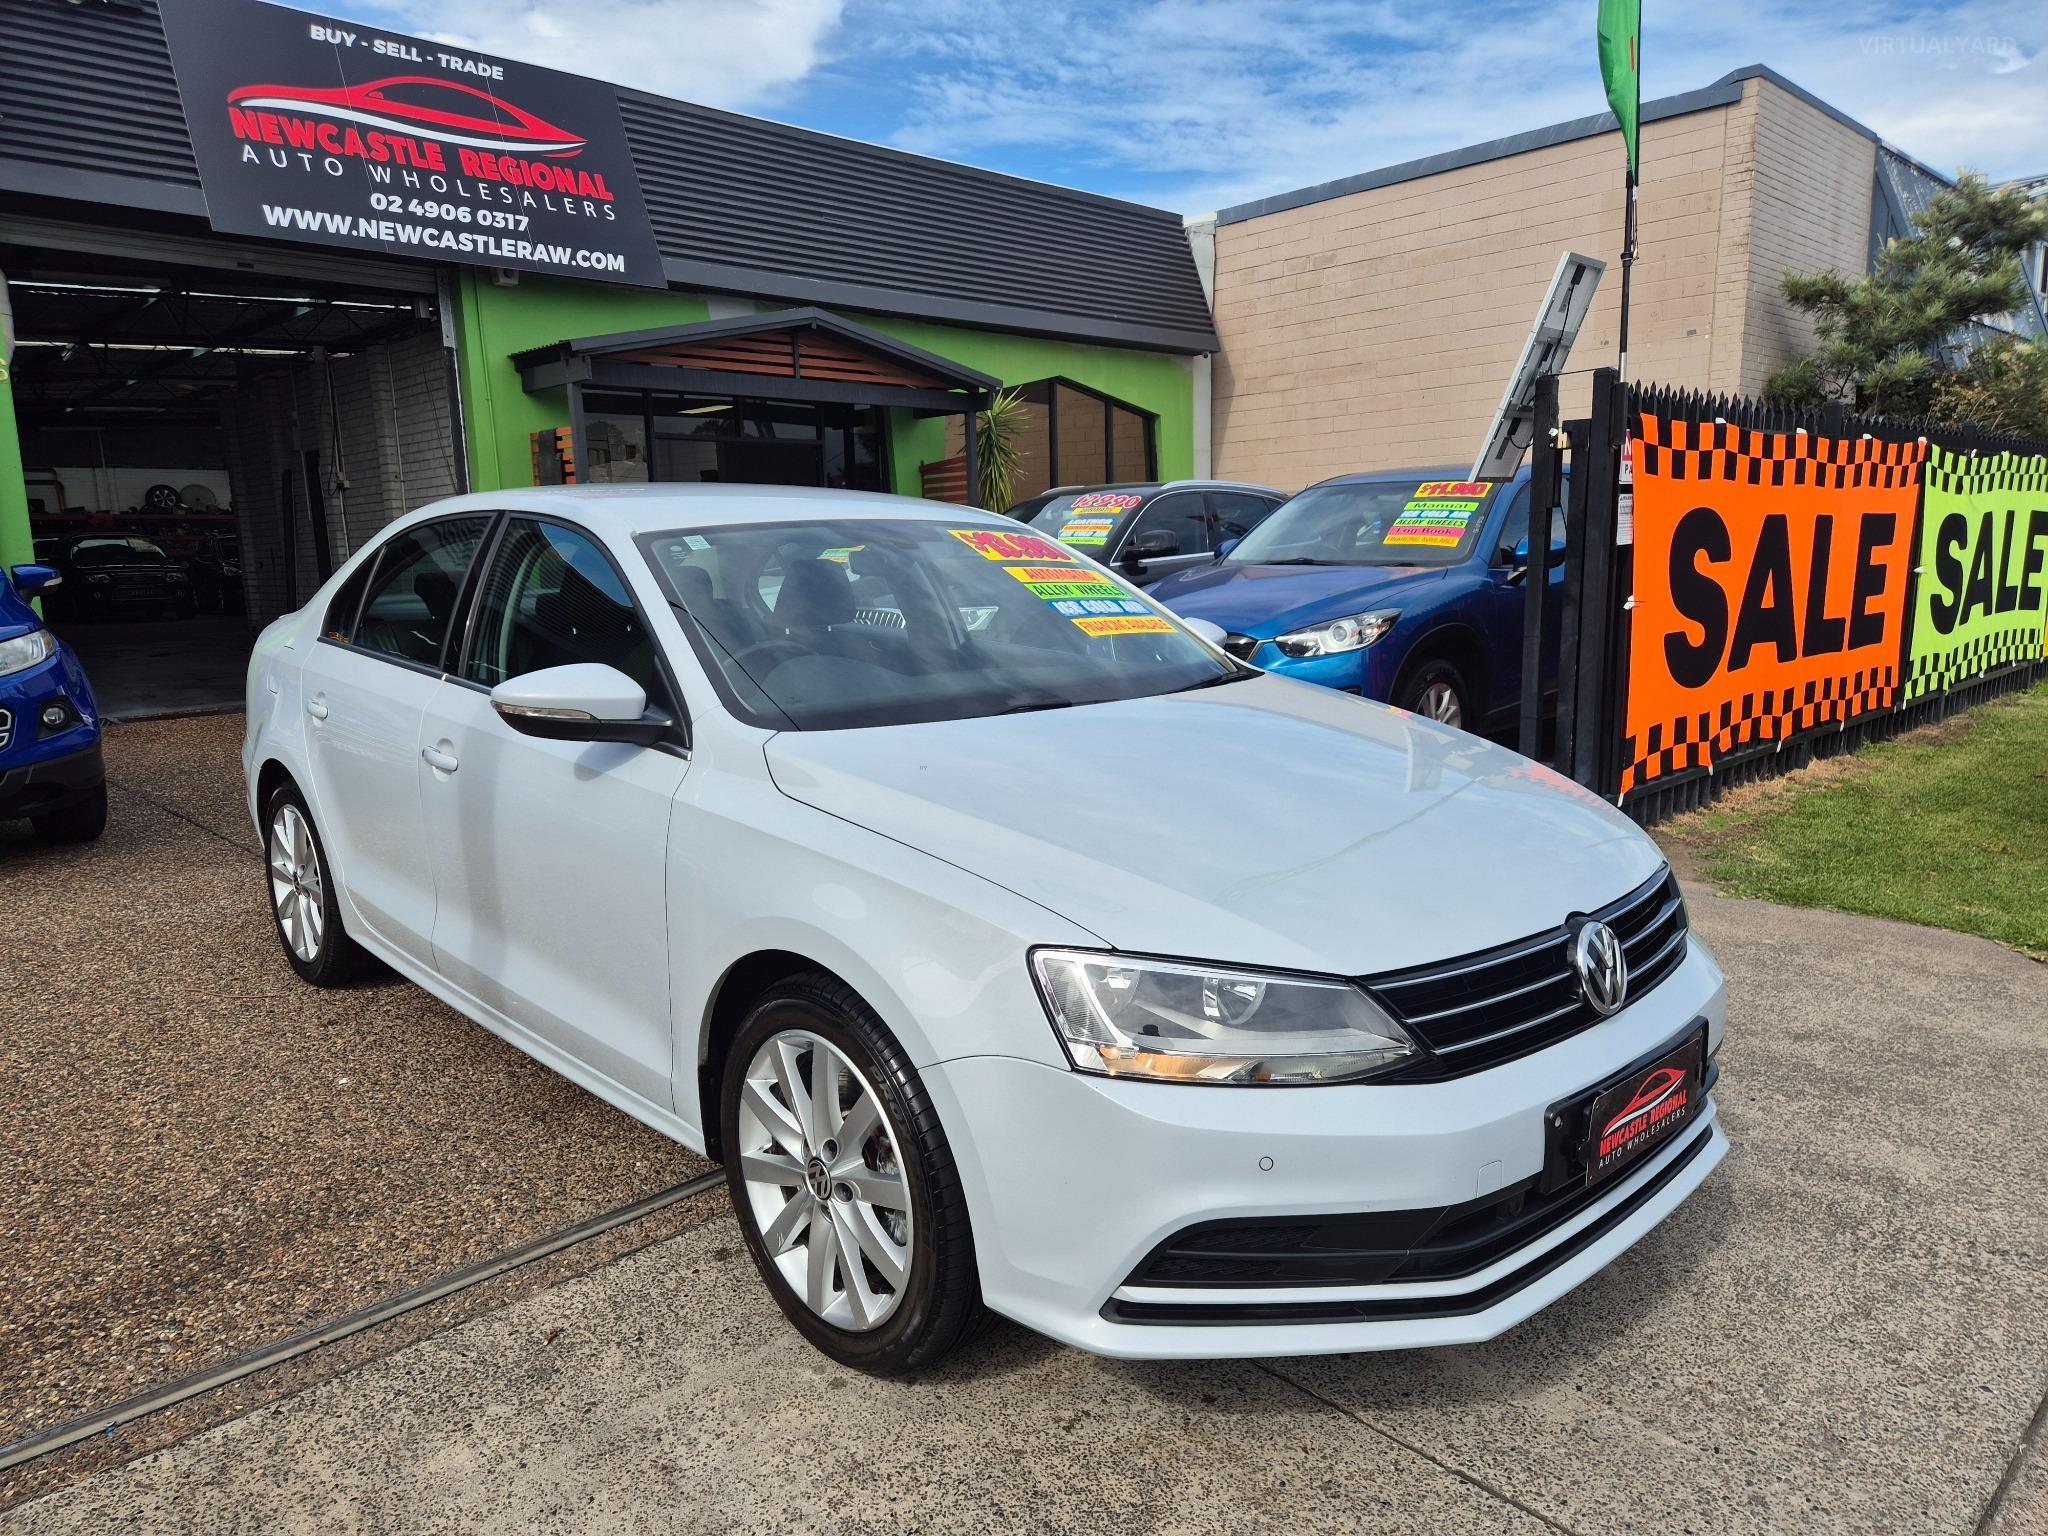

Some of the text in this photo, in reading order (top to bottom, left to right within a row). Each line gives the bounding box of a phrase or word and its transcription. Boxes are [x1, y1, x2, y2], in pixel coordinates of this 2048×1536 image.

[310, 24, 357, 47] BUY
[373, 39, 422, 62] SELL
[438, 52, 504, 80] TRADE
[228, 106, 614, 201] NEWCASTLE REGIONAL
[242, 144, 615, 220] AUTO WHOLESALERS
[262, 204, 624, 273] WWW.NEWCASTLERAW.COM
[370, 192, 529, 232] 02 4906 0317
[1427, 519, 1465, 527] WHEELS
[1033, 584, 1126, 597] ALLOY WHEELS
[1663, 507, 1897, 688] SALE
[1930, 510, 2048, 635] SALE
[1052, 600, 1152, 616] ICE COLD AIR
[1599, 1106, 1686, 1169] AUTO WHOLESALERS
[1600, 1090, 1687, 1157] NEWCASTLE REGIONAL
